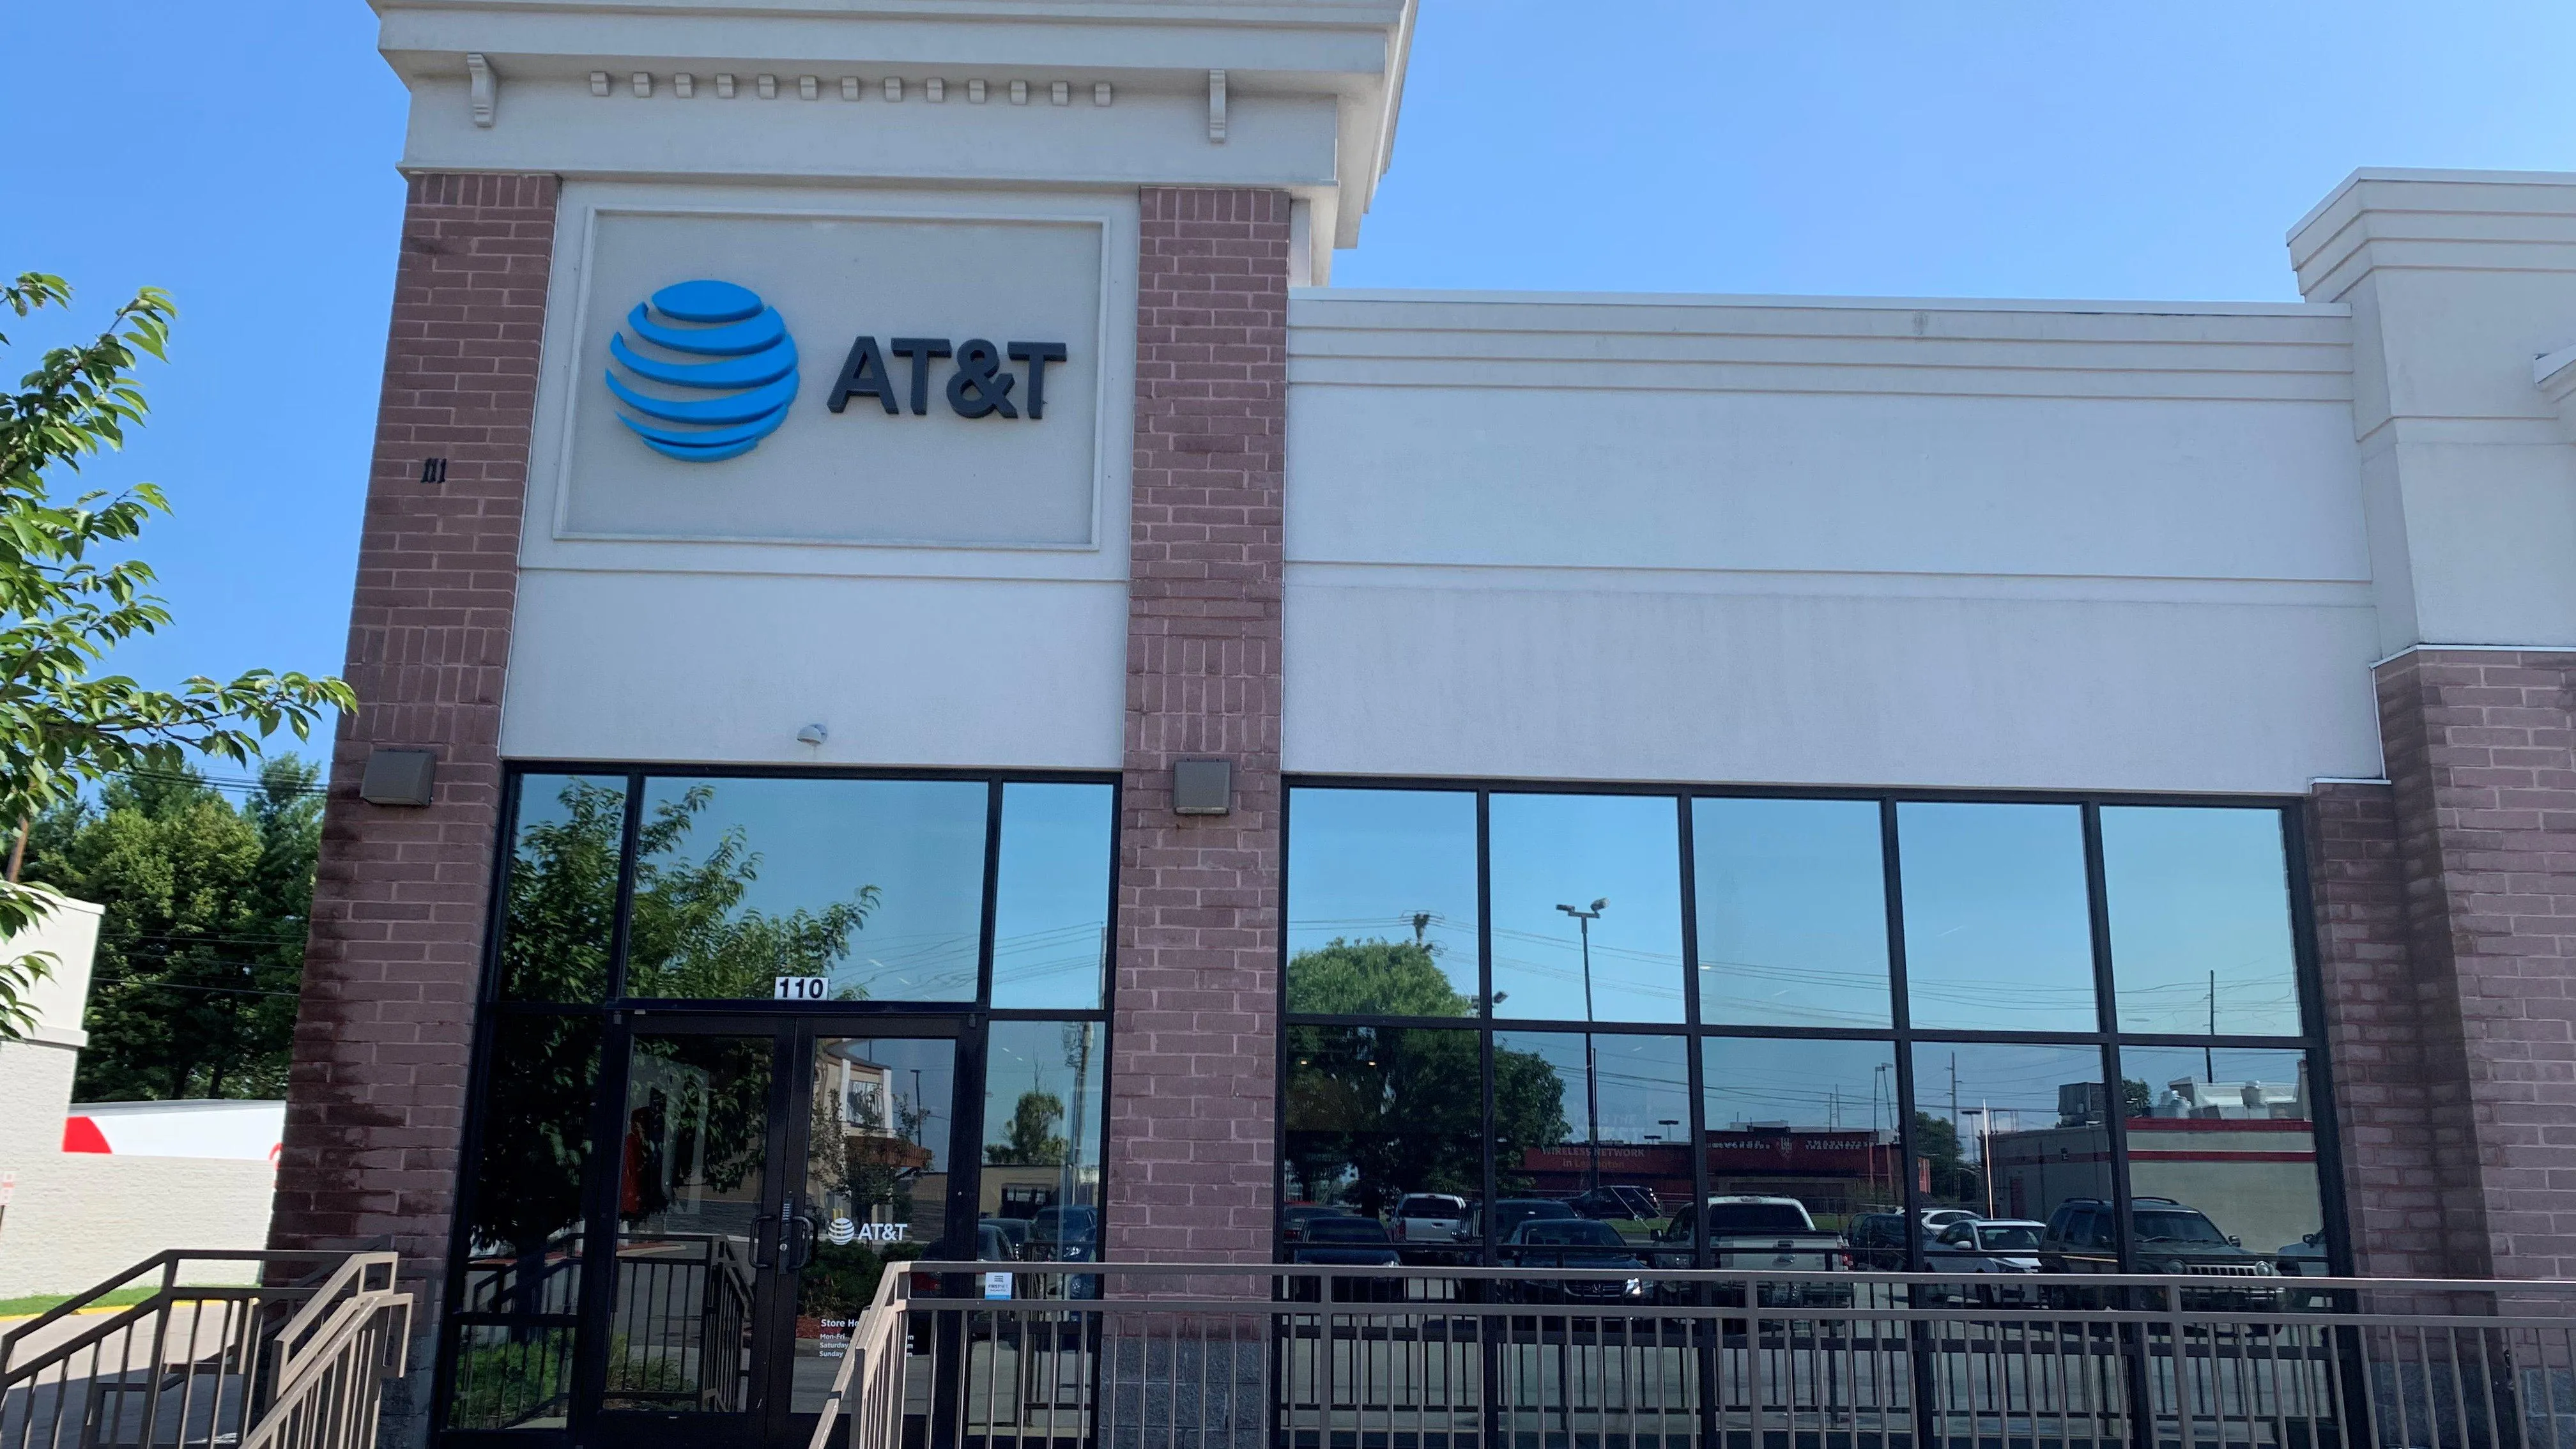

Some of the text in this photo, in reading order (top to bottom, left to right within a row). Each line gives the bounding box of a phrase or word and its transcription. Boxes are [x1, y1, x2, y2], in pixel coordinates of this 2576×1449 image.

[827, 336, 1068, 420] AT&T
[779, 978, 824, 999] 110
[857, 1223, 908, 1241] AT&T
[820, 1319, 845, 1328] Store
